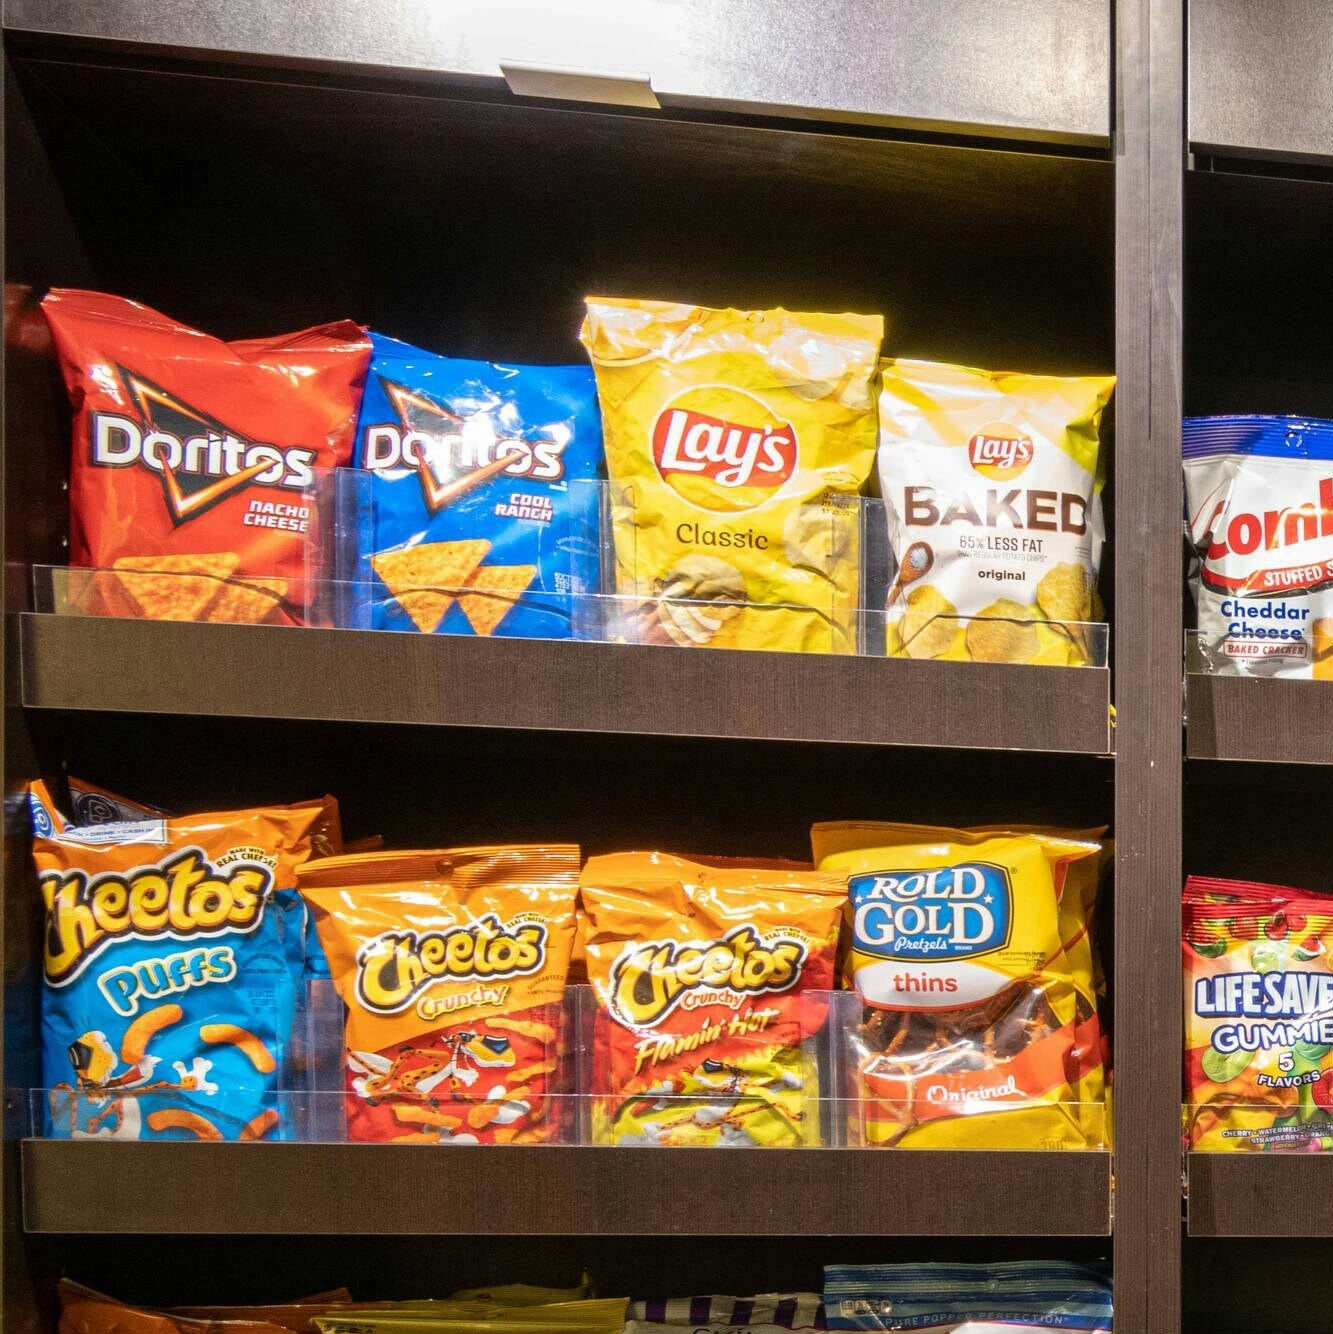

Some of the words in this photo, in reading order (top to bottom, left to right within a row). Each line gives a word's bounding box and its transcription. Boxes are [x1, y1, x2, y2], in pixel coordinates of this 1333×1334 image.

[94, 415, 315, 486] Doritos
[366, 428, 566, 480] Doritos
[660, 410, 790, 486] Lay's
[972, 435, 1032, 468] Lay's
[249, 501, 309, 519] NACHO
[495, 504, 553, 521] RANCH
[510, 493, 552, 508] COOL
[905, 486, 1087, 536] BAKED
[243, 513, 308, 532] CHEESE
[676, 523, 769, 552] Classic
[987, 536, 1017, 552] LESS
[1021, 538, 1043, 553] FAT
[978, 569, 1026, 582] original
[1264, 567, 1323, 587] STUFFED
[1221, 601, 1309, 620] Cheddar
[1228, 622, 1302, 641] Cheese
[873, 867, 984, 902] ROLD
[42, 850, 266, 979] Cheetos
[856, 903, 993, 948] GOLD
[894, 936, 947, 953] Pretzels
[361, 921, 543, 1008] Cheetos
[618, 925, 803, 1025] Cheetos
[893, 971, 957, 994] thins
[418, 984, 509, 1019] Crunchy
[682, 989, 743, 1010] Crunchy
[633, 1018, 725, 1071] Flamin'
[1279, 1052, 1294, 1071] 5
[927, 1075, 1027, 1105] Original
[1259, 1071, 1320, 1087] FLAVORS
